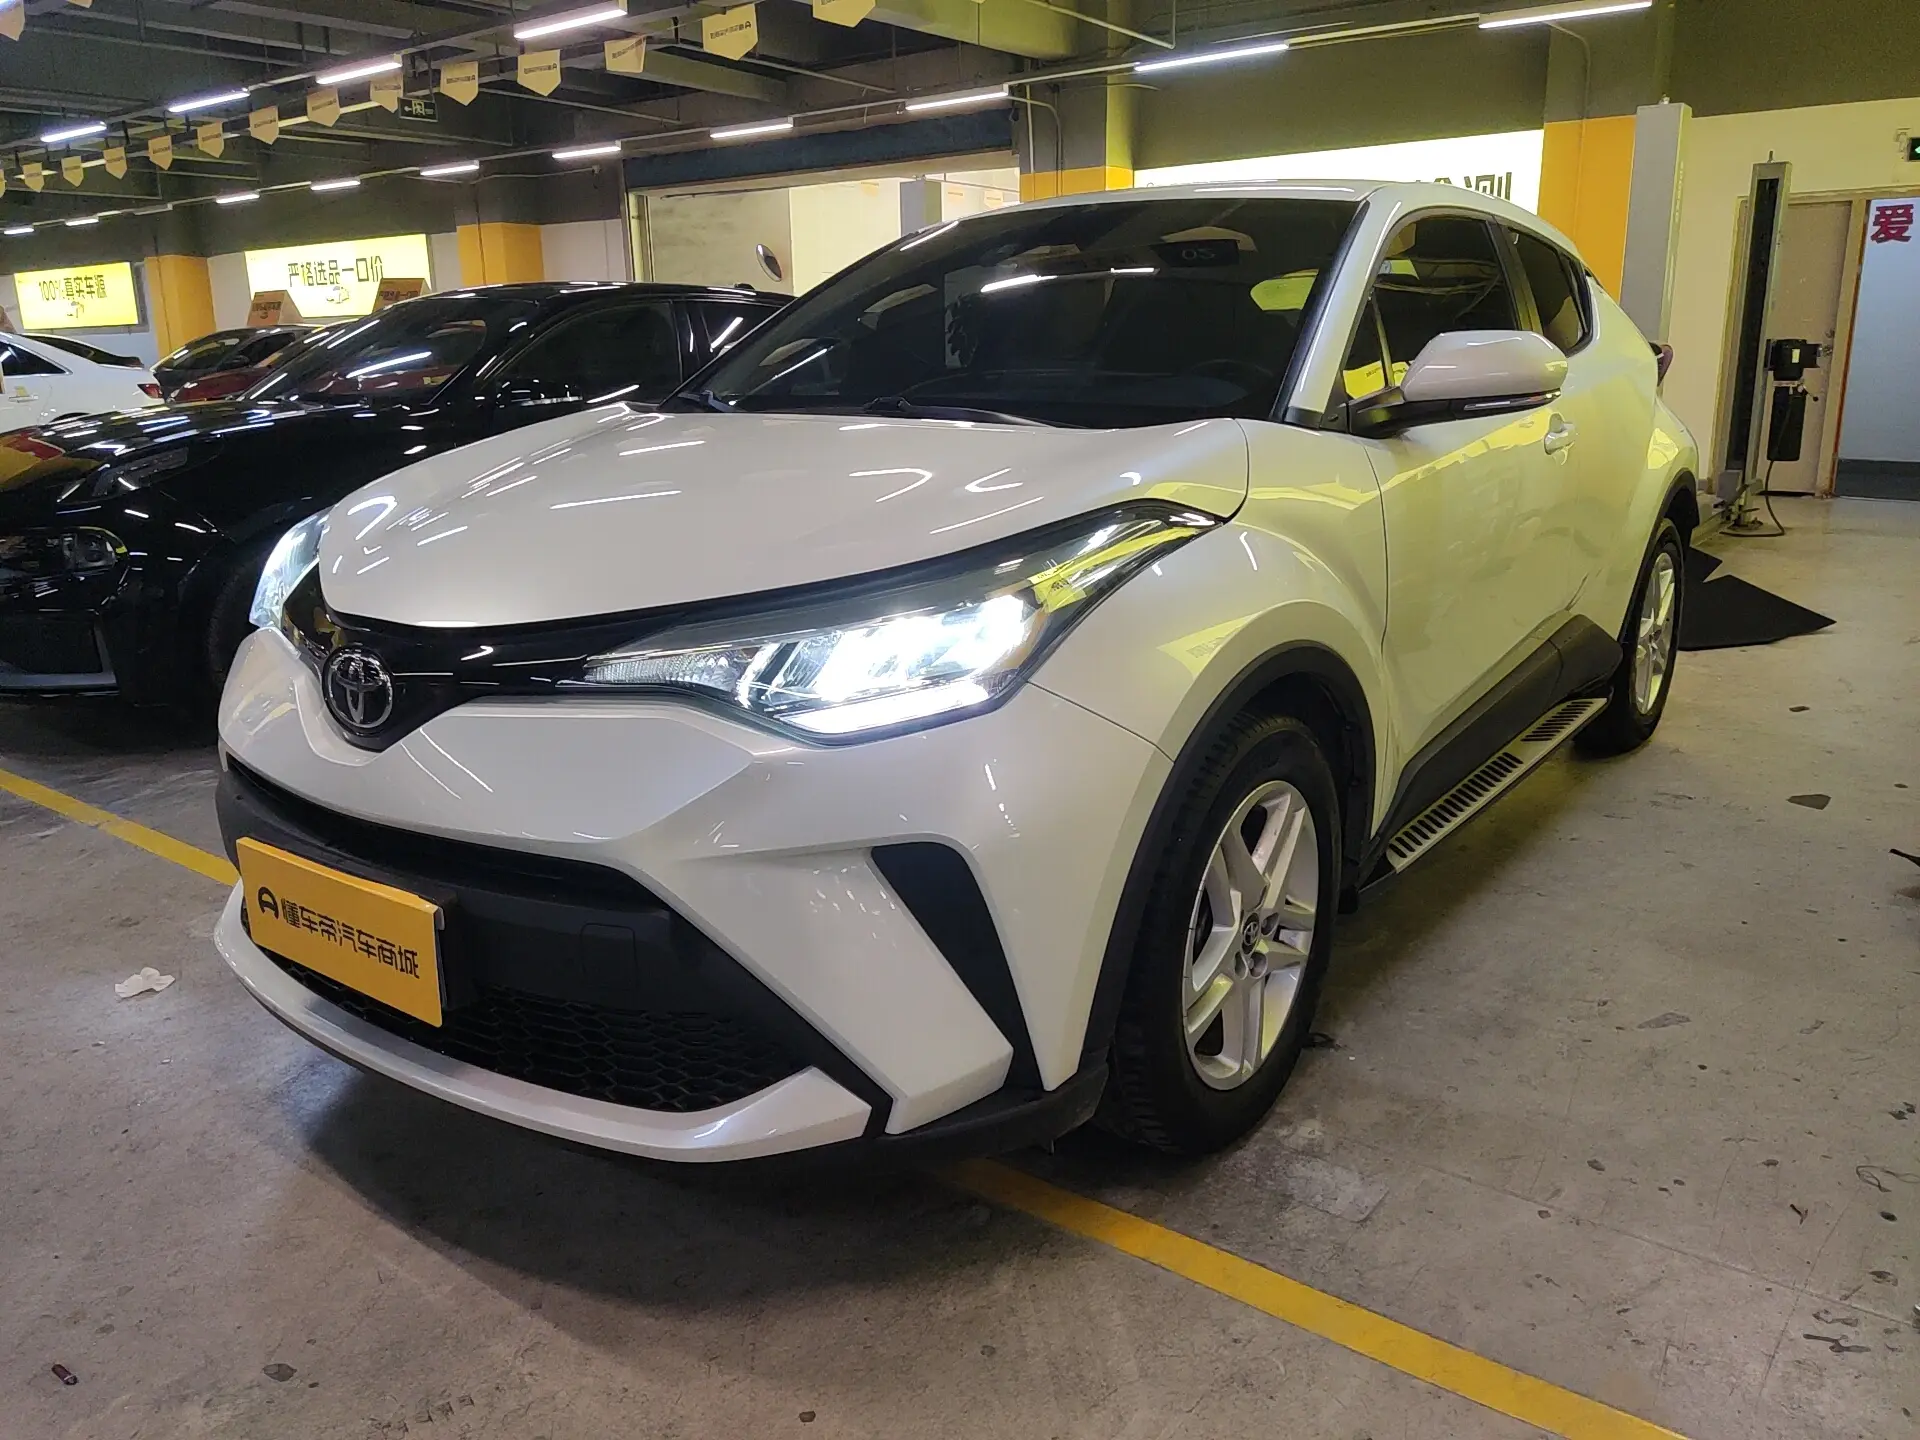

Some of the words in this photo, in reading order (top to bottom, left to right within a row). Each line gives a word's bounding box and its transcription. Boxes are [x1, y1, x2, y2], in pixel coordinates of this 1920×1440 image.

[1870, 203, 1914, 244] 爱
[287, 255, 383, 287] 严格选品一口价
[281, 897, 420, 979] 懂车帝汽车商城
